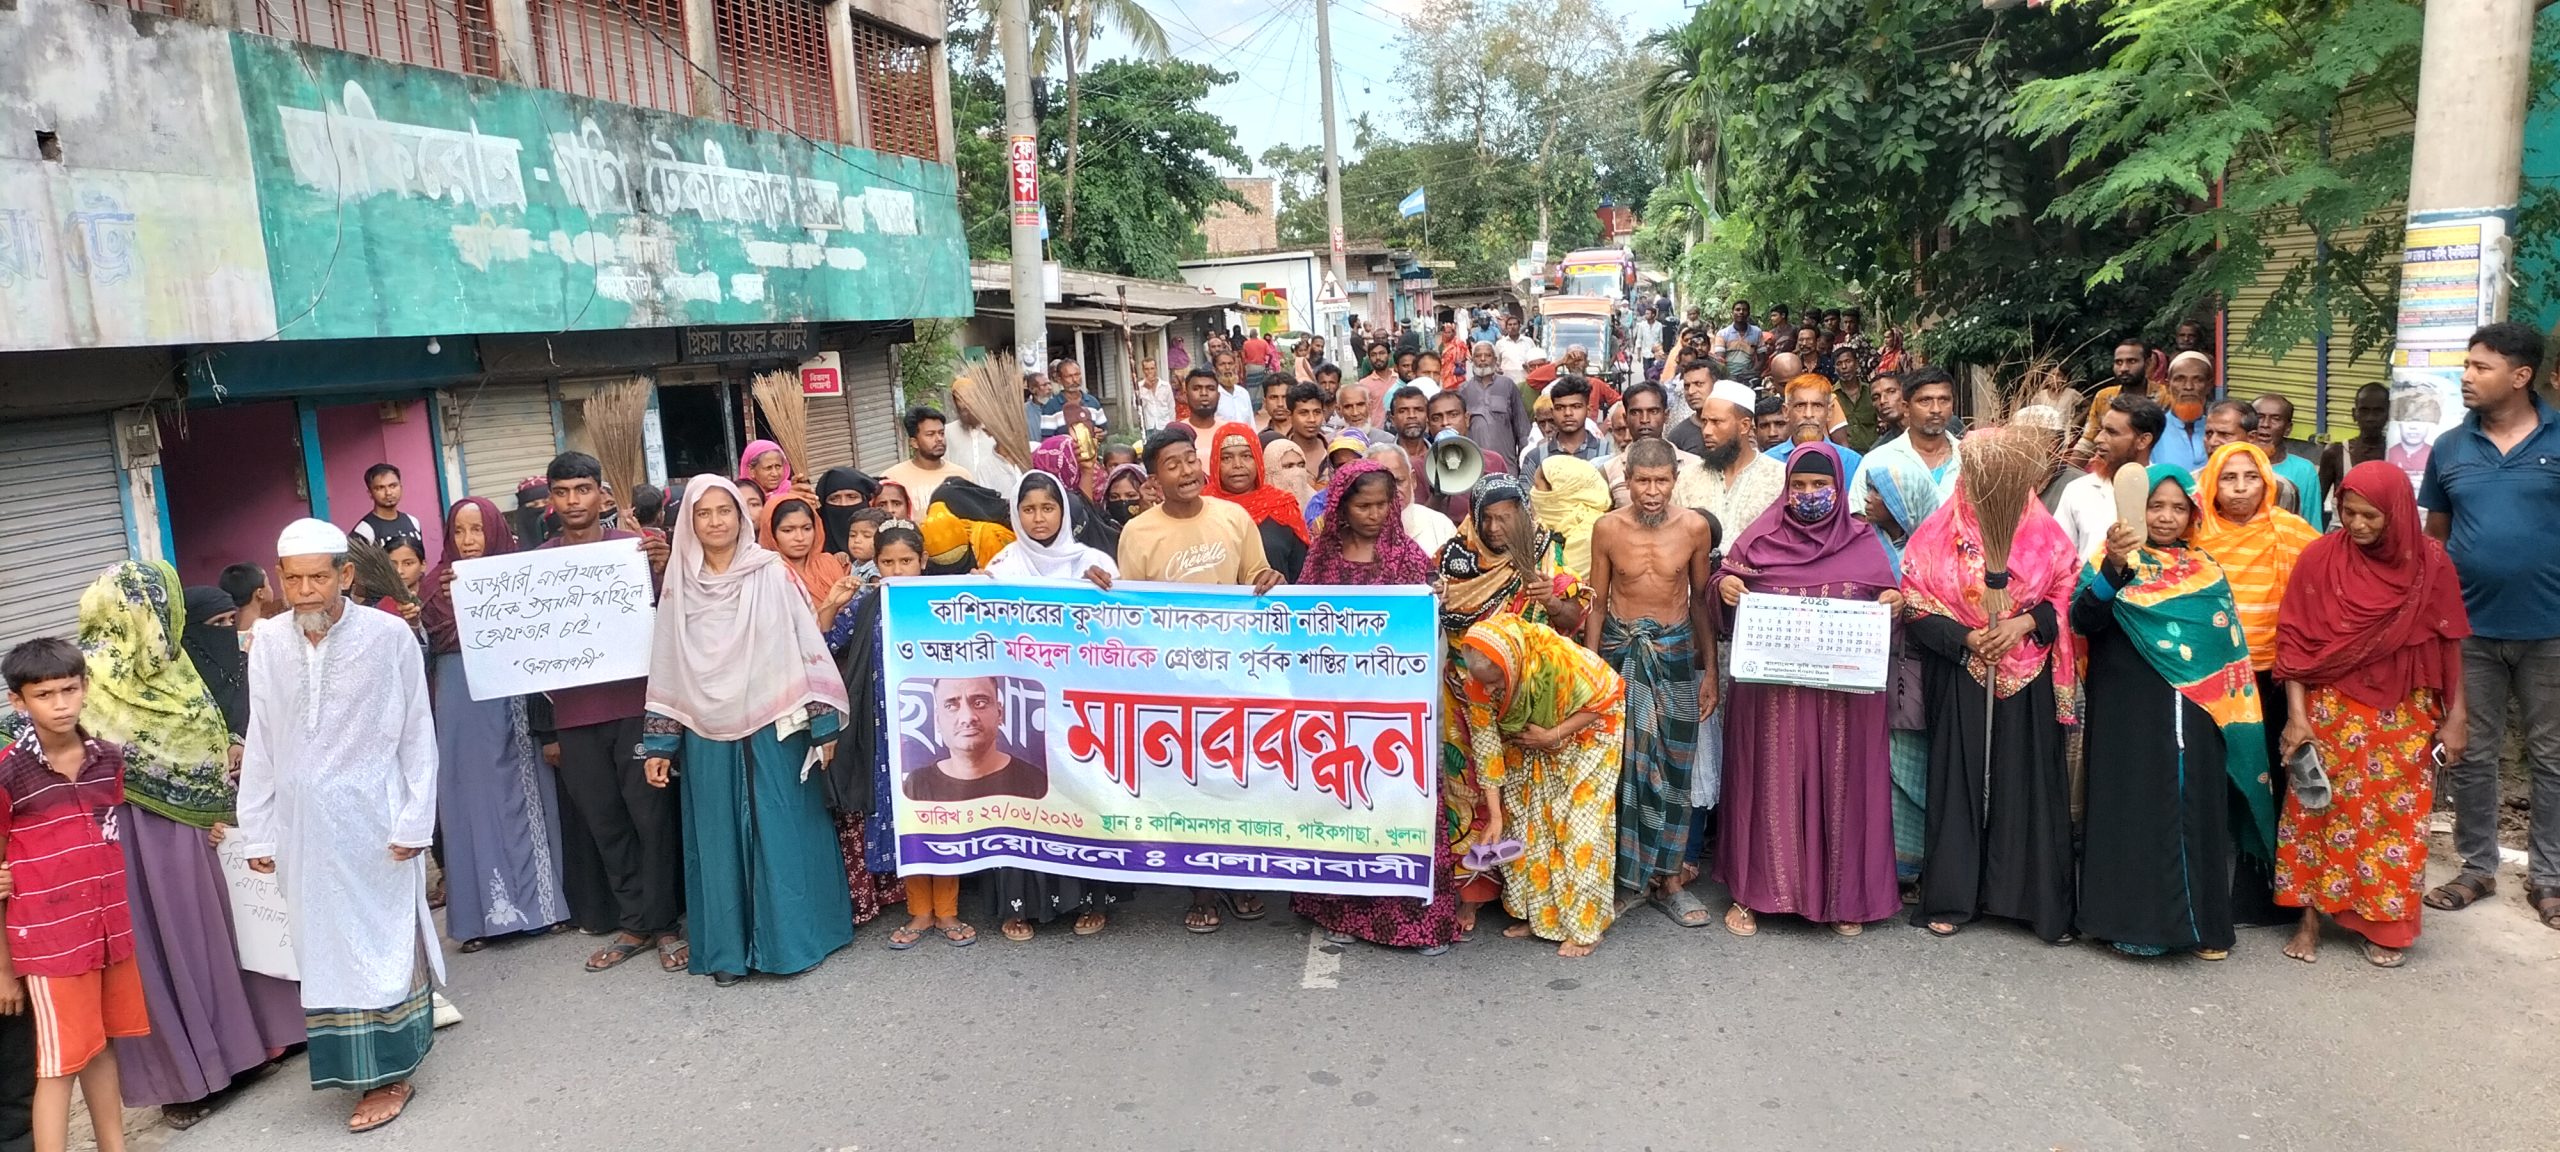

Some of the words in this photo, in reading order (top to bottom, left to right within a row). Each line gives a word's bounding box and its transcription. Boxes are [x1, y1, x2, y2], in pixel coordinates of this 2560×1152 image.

[728, 328, 768, 353] হেয়ার
[770, 323, 808, 351] কাটিং
[931, 596, 1064, 624] কাশিমনগরের
[1071, 604, 1145, 633] কুখ্যাত
[1151, 604, 1290, 633] মাদকব্যবসায়ী
[1297, 603, 1388, 635] নারীখাদক
[1800, 597, 1830, 607] 2026
[897, 643, 914, 659] ও
[920, 633, 998, 663] অস্ত্রধারী
[1004, 635, 1072, 669] মহিদুল
[1079, 639, 1158, 668] গাজীকে
[1165, 646, 1231, 671] গ্রেপ্তার
[1239, 644, 1291, 679] পূর্বক
[1297, 646, 1349, 673] শাস্তির
[1353, 646, 1428, 675] দাবীতে
[1063, 690, 1432, 809] মানববন্ধন
[914, 806, 962, 825] তারিখ
[980, 802, 1084, 828] ২৭/০৬/২০২৬
[1100, 813, 1128, 833] স্থান
[1149, 811, 1231, 835] কাশিমনগর
[1385, 826, 1428, 848] খুলনা
[924, 833, 1132, 866] আয়োজনে
[1183, 853, 1425, 880] এলাকাবাসী
